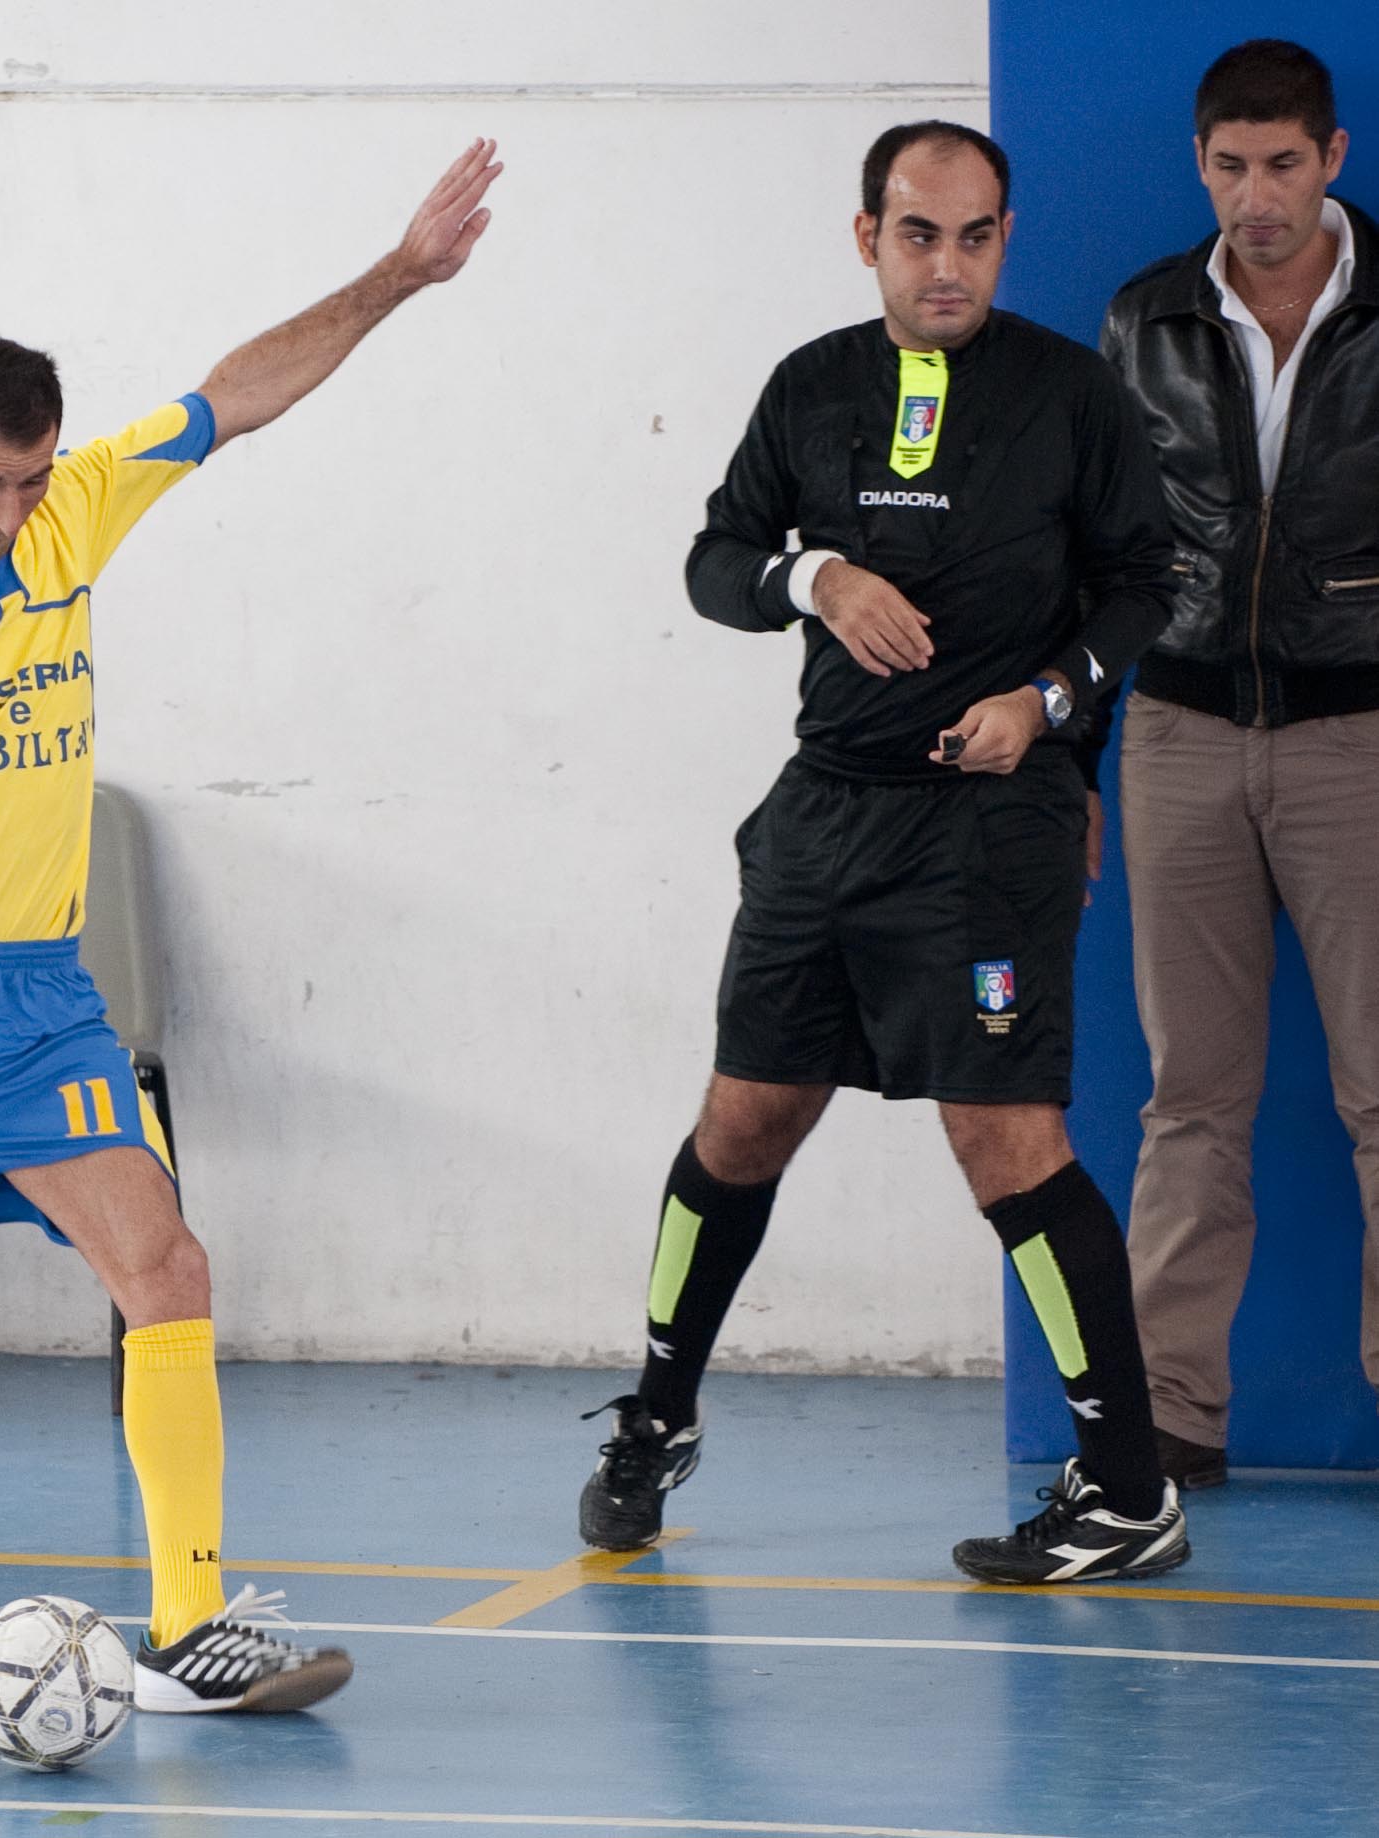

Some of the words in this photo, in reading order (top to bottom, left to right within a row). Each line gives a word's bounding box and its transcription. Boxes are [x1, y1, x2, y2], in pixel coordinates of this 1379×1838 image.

[859, 491, 950, 510] DIADORA
[10, 700, 31, 725] e
[978, 964, 1009, 972] ITALIA
[58, 1078, 122, 1138] 11
[193, 1549, 222, 1565] LE
